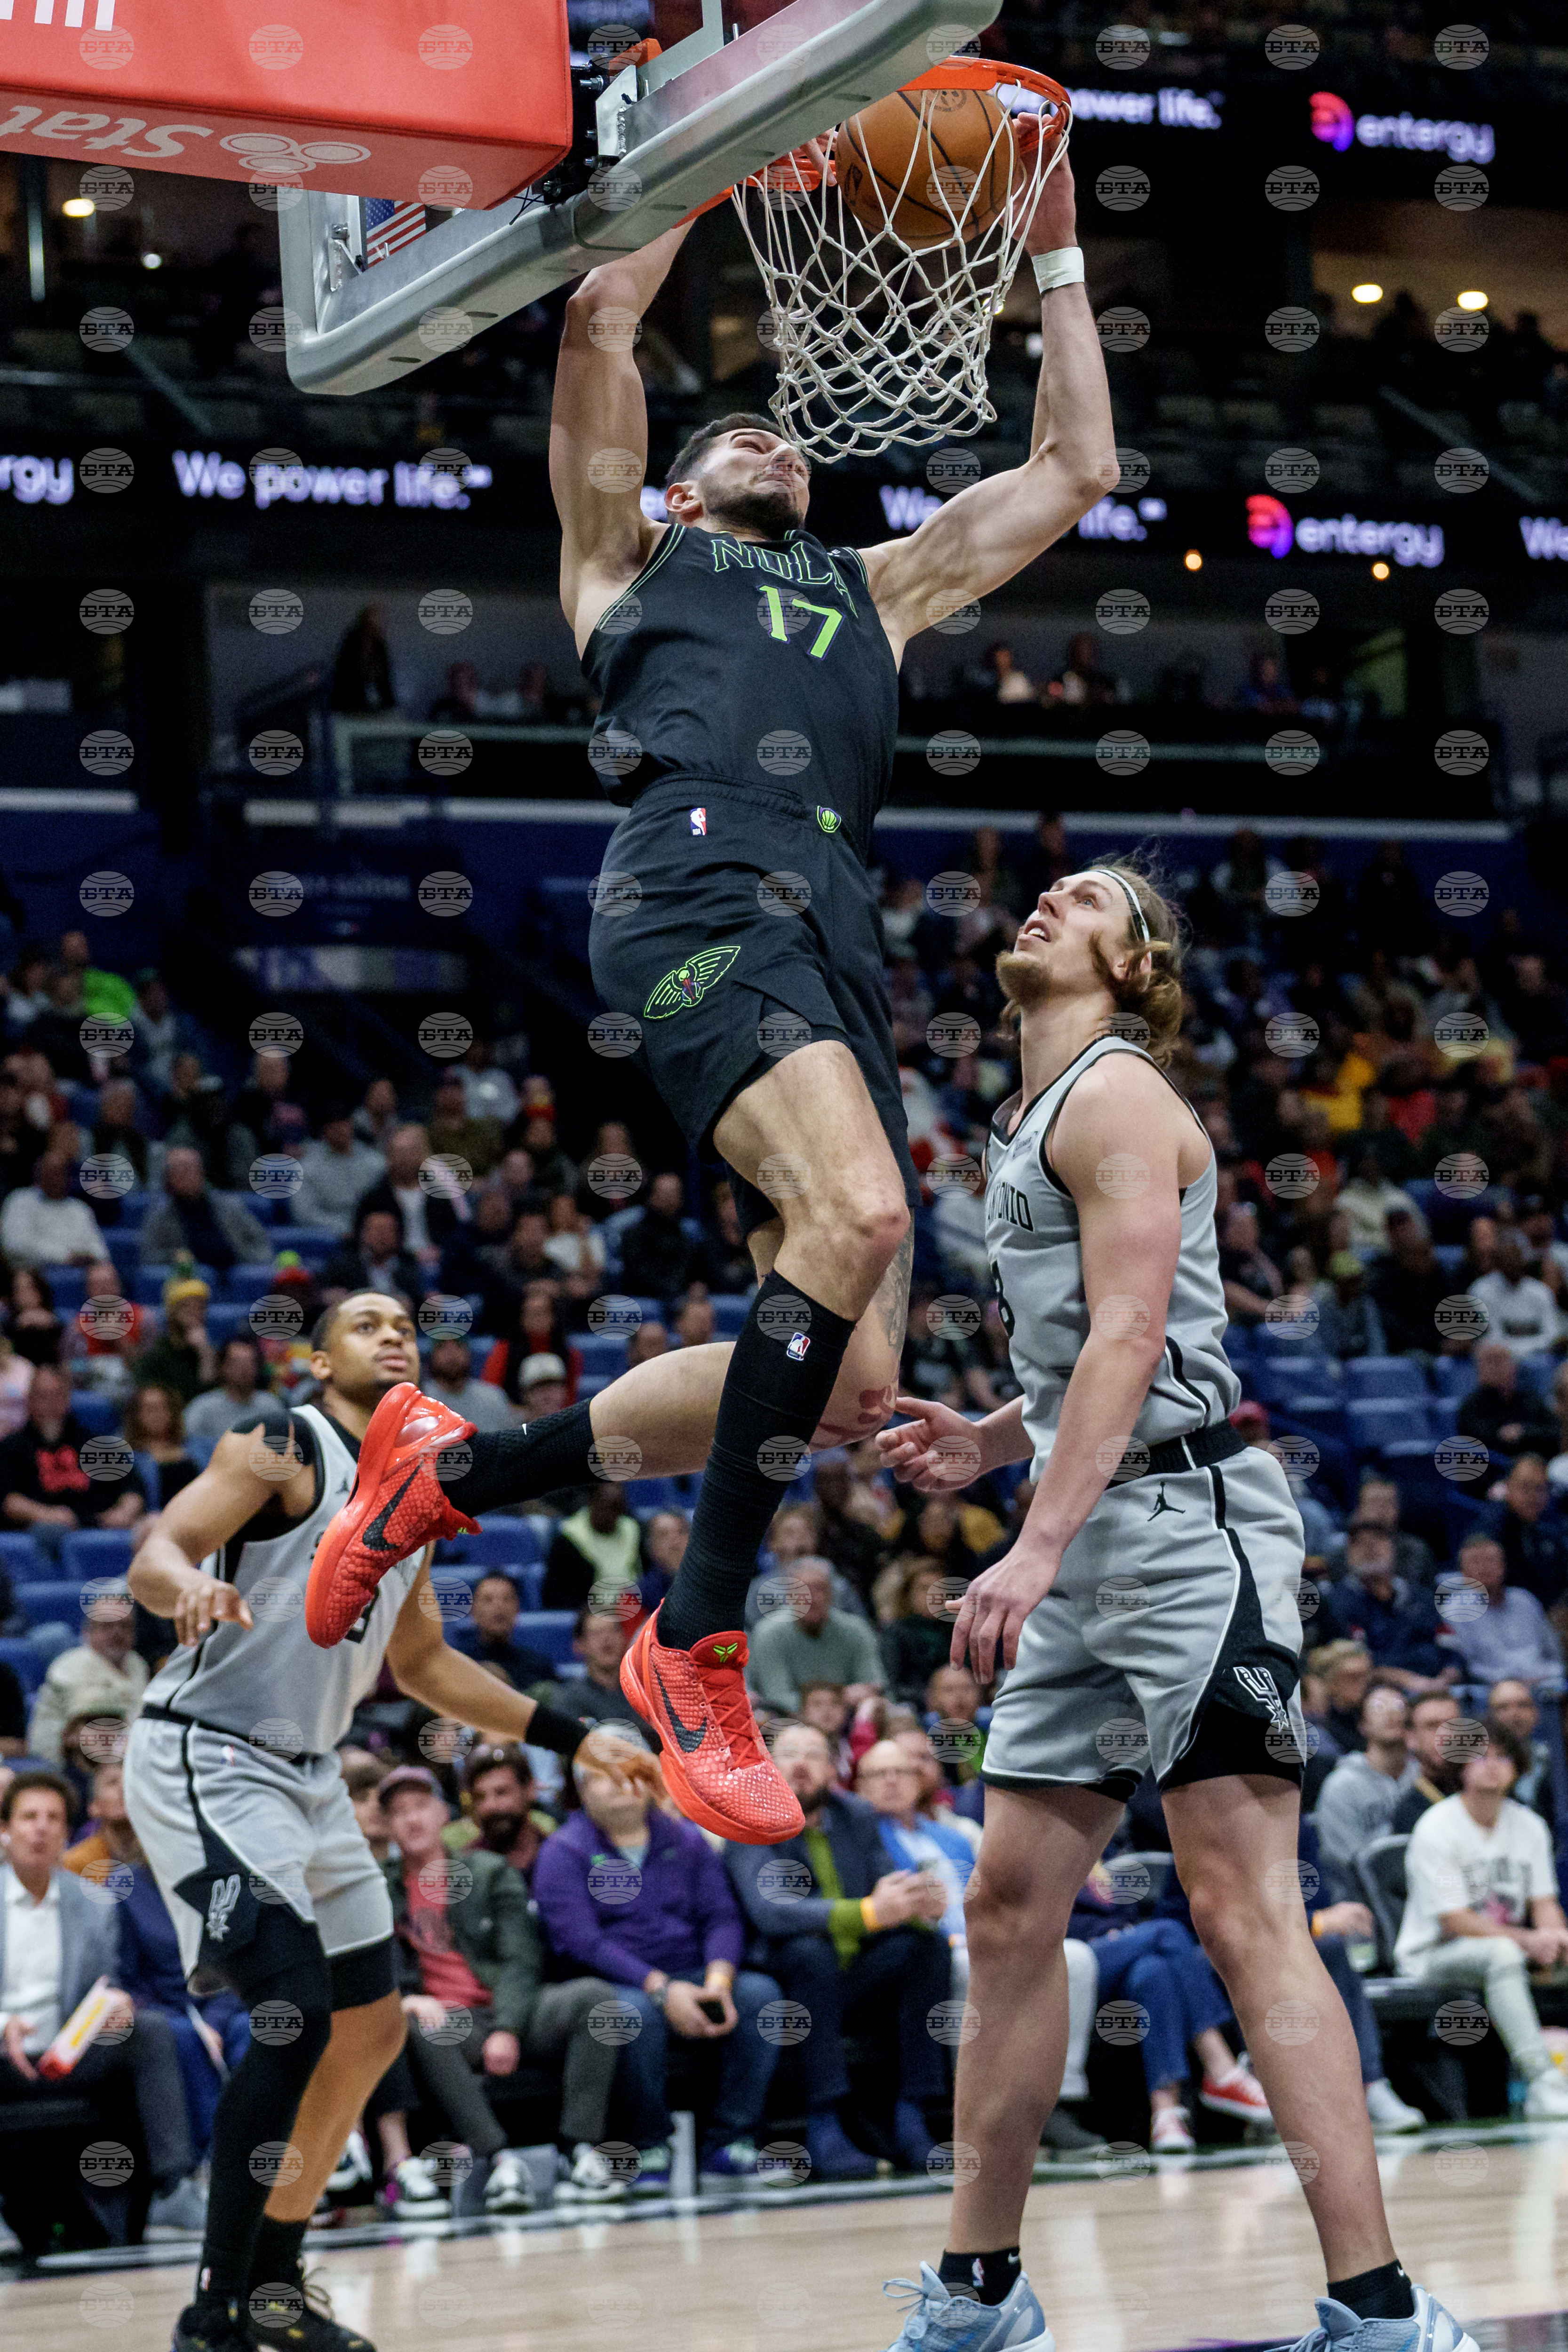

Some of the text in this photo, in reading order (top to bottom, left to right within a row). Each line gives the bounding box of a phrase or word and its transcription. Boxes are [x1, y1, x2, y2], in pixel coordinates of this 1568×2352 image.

[1050, 87, 1156, 125] ower
[172, 449, 247, 499] We
[255, 463, 389, 509] power
[1296, 513, 1444, 568] entergy
[756, 585, 846, 660] 17
